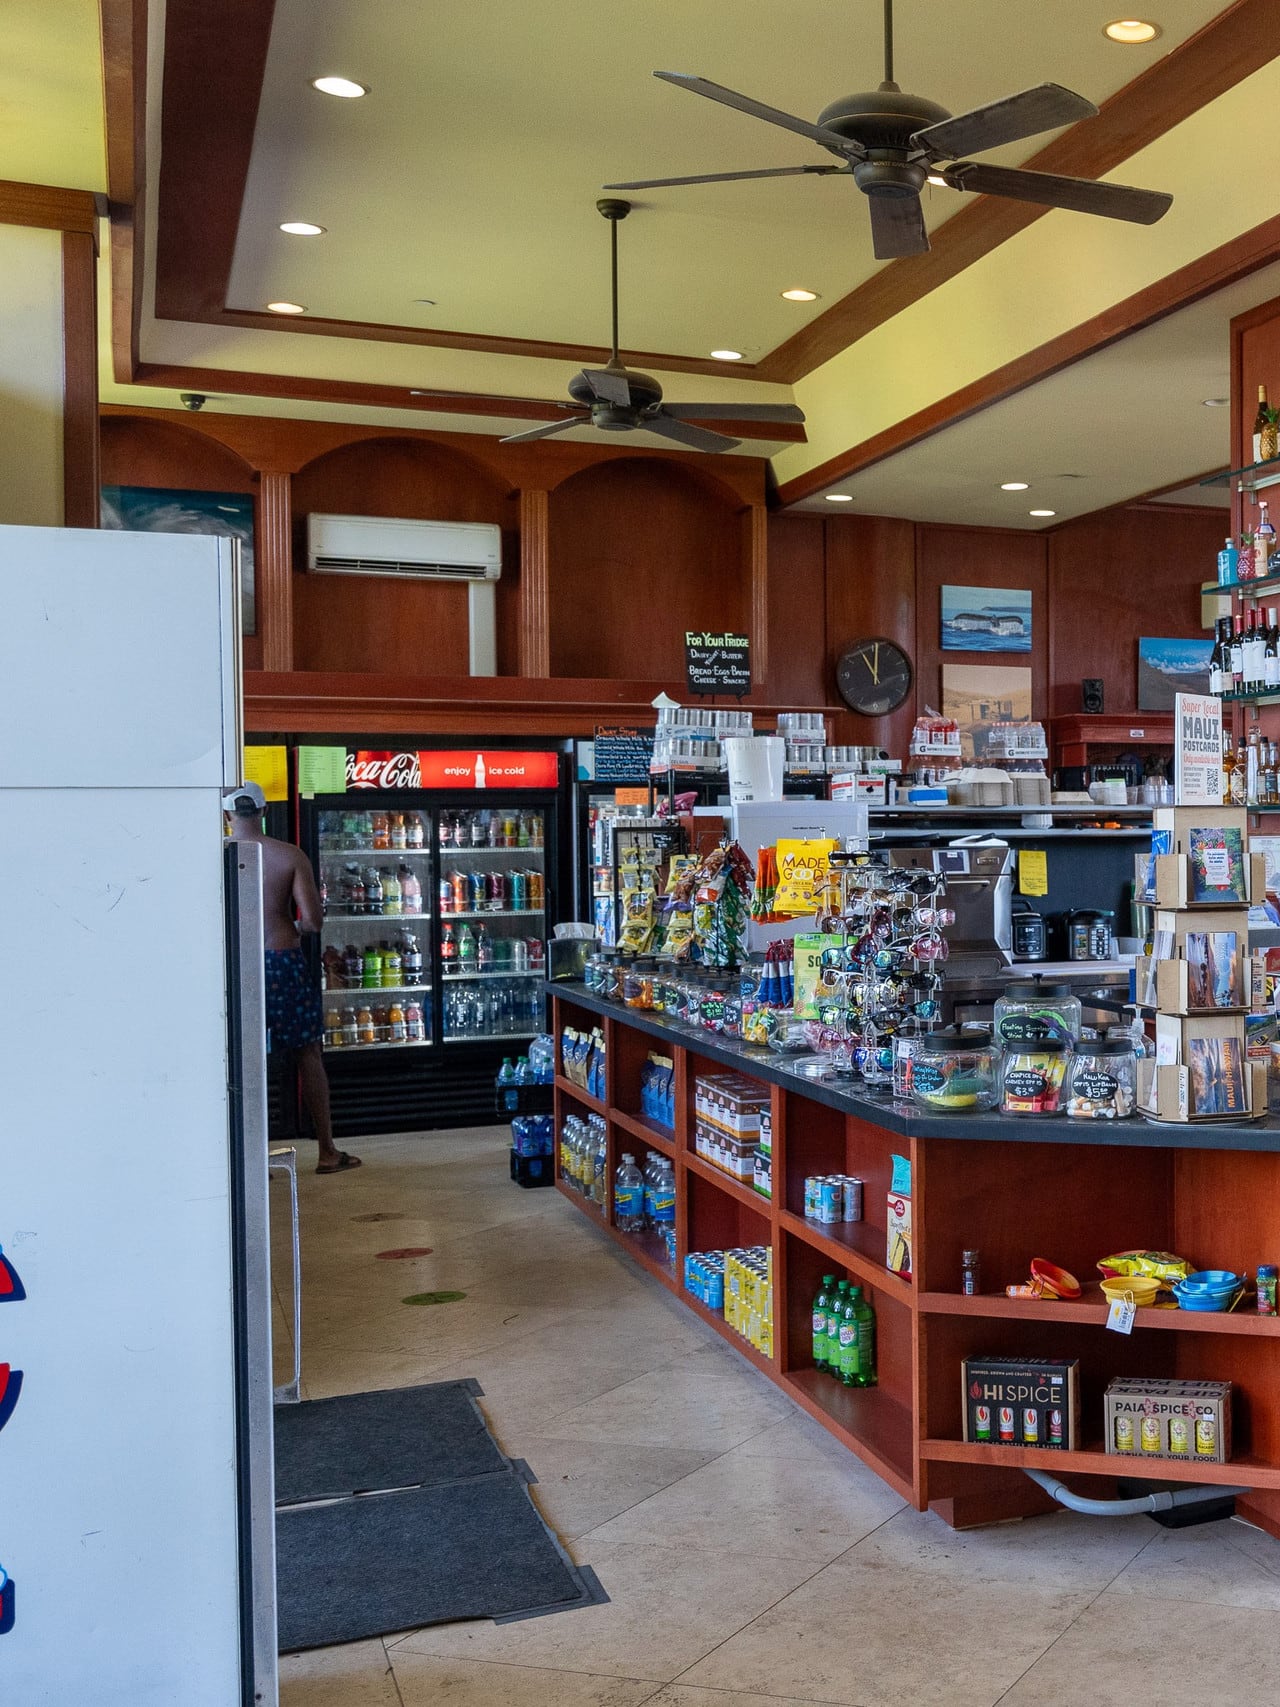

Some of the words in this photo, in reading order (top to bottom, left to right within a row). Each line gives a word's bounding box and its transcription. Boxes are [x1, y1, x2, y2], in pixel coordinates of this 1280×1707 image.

[685, 632, 702, 646] FOR
[702, 632, 724, 647] YOUR
[724, 633, 749, 647] FRIDGE
[689, 665, 712, 675] BREAD
[714, 665, 730, 675] EGGS
[1182, 698, 1201, 716] Super
[1203, 701, 1219, 717] Local
[1183, 716, 1219, 740] MAUI
[1183, 740, 1219, 753] POSTCARDS
[444, 767, 471, 776] enjoy
[489, 767, 503, 775] ice
[505, 767, 525, 775] cold
[782, 857, 825, 869] MADE
[783, 868, 824, 882] GOOD
[1223, 1042, 1233, 1077] HAWAII
[984, 1384, 1003, 1400] HI
[1006, 1385, 1061, 1403] SPICE
[1117, 1386, 1168, 1395] PACK
[1176, 1389, 1222, 1397] GIFT
[1115, 1402, 1146, 1413] PAIA
[1152, 1404, 1189, 1415] SPICE
[1195, 1406, 1216, 1416] CO.
